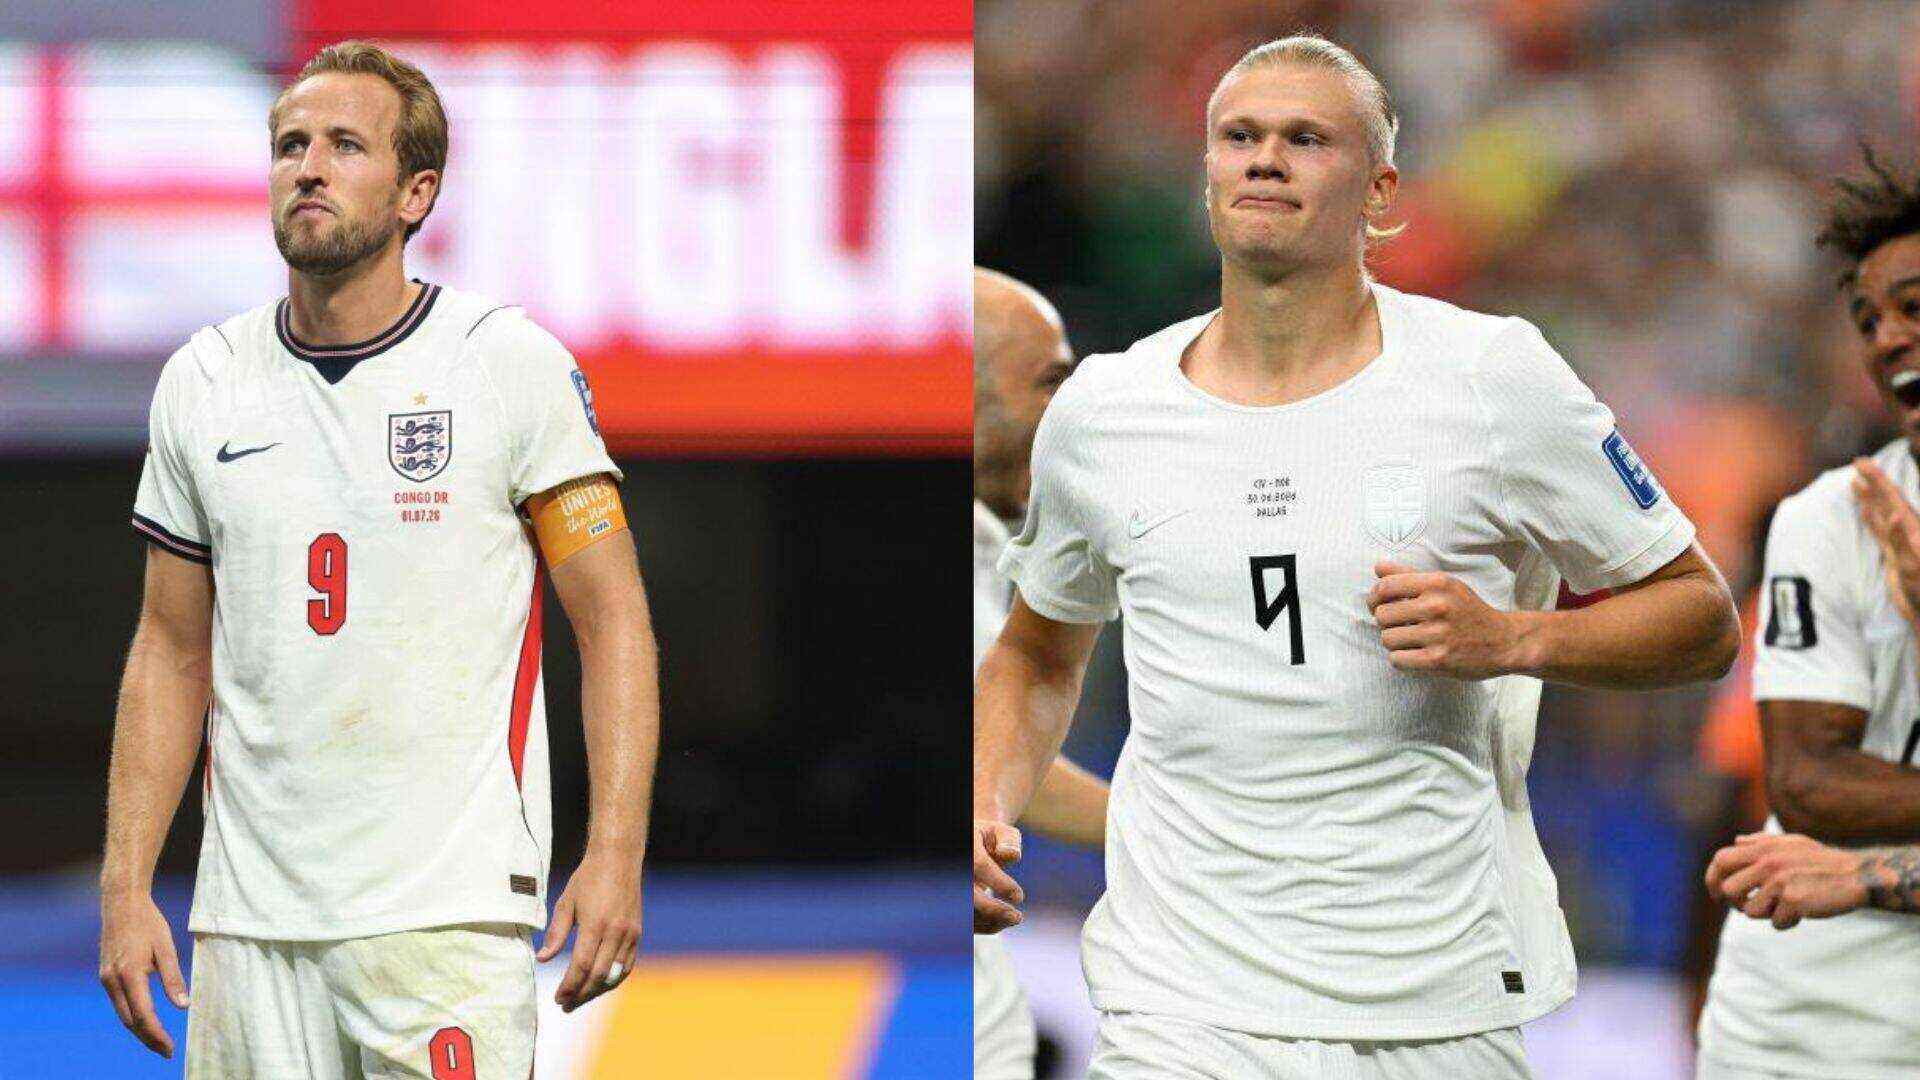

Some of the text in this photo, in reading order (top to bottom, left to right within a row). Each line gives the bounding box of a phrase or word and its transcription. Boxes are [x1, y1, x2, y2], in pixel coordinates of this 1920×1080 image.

[394, 491, 448, 504] CONGO DR
[402, 509, 440, 522] 01.07.26
[1256, 505, 1287, 517] DALLAS
[307, 532, 348, 636] 9
[1249, 554, 1305, 665] 9
